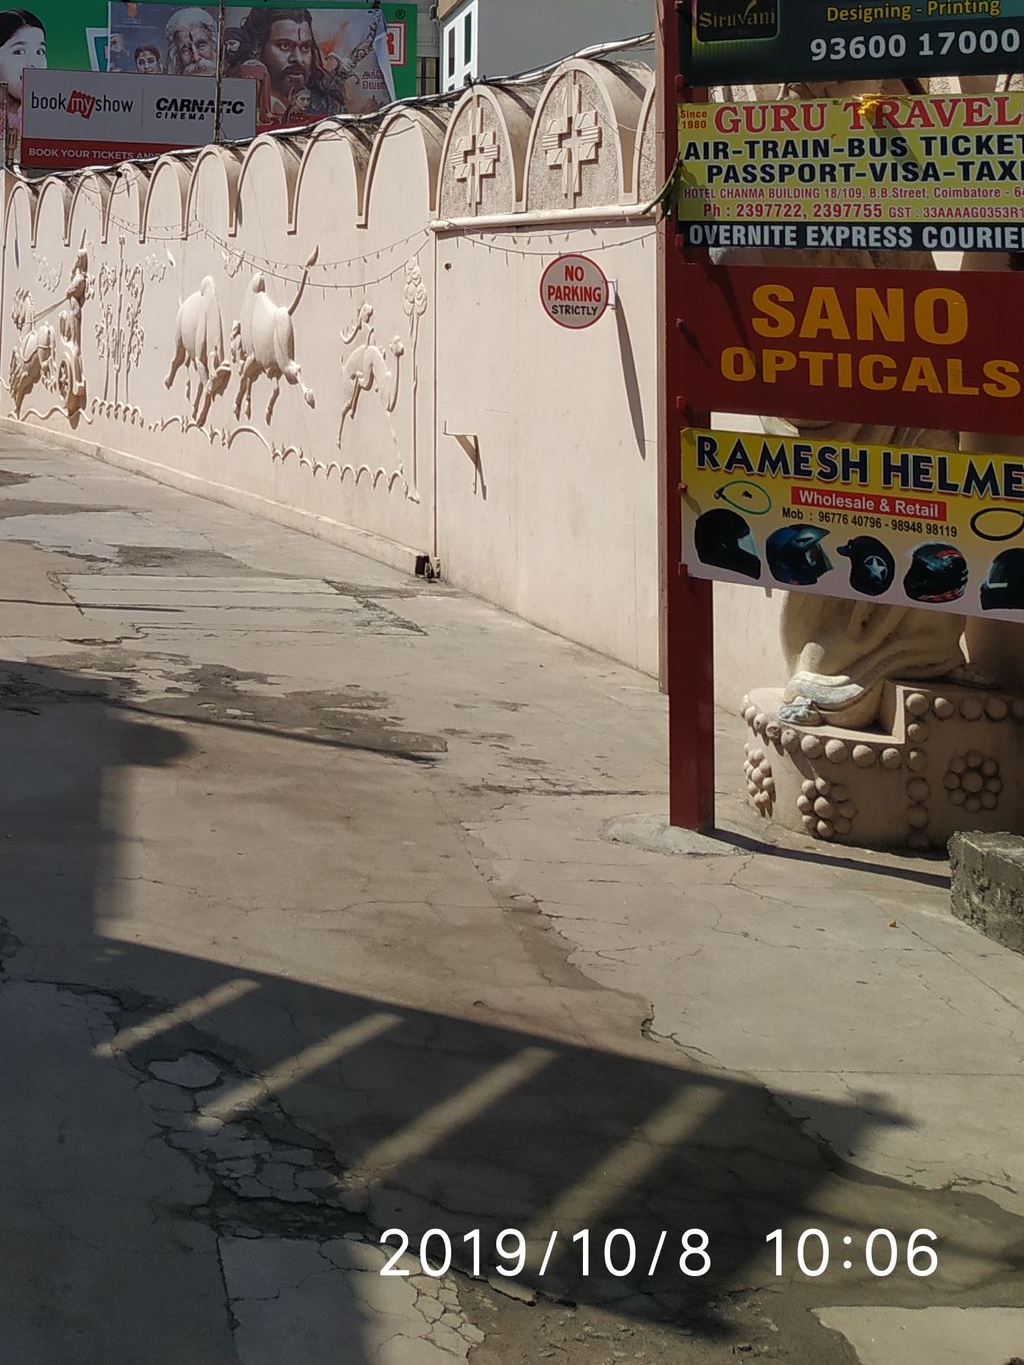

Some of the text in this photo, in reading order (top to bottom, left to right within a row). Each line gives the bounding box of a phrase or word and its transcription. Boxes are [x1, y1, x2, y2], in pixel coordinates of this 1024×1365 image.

[698, 0, 776, 29] Siruvani
[827, 4, 912, 24] Designing
[809, 28, 1021, 61] 93600 17000
[155, 111, 205, 121] CINEMA
[679, 96, 1024, 134] Since GURU TRAVEL
[681, 120, 707, 130] 1980
[28, 147, 58, 157] BOOK
[61, 149, 90, 159] YOUR
[92, 150, 133, 160] TICKETS
[684, 135, 908, 161] AIR-TRAIN-BUS
[684, 188, 717, 199] HOTEL
[720, 188, 765, 199] CHANMA
[768, 188, 820, 199] BUILDING
[933, 187, 1001, 199] Coimbatore
[703, 203, 721, 217] Ph
[813, 204, 883, 218] 2397755
[888, 207, 912, 218] GST
[689, 224, 797, 246] OVERNITE
[806, 225, 913, 248] EXPRESS
[564, 265, 584, 282] NO
[547, 285, 602, 303] PARKING
[551, 304, 598, 316] STRICTLY
[751, 284, 969, 345] SANO
[720, 346, 1022, 398] OPTICALS
[695, 435, 1024, 501] RAMESH HELME
[798, 489, 938, 518] Wholesale & Retail
[782, 506, 958, 538] Mob 96776 40796 98948 98119
